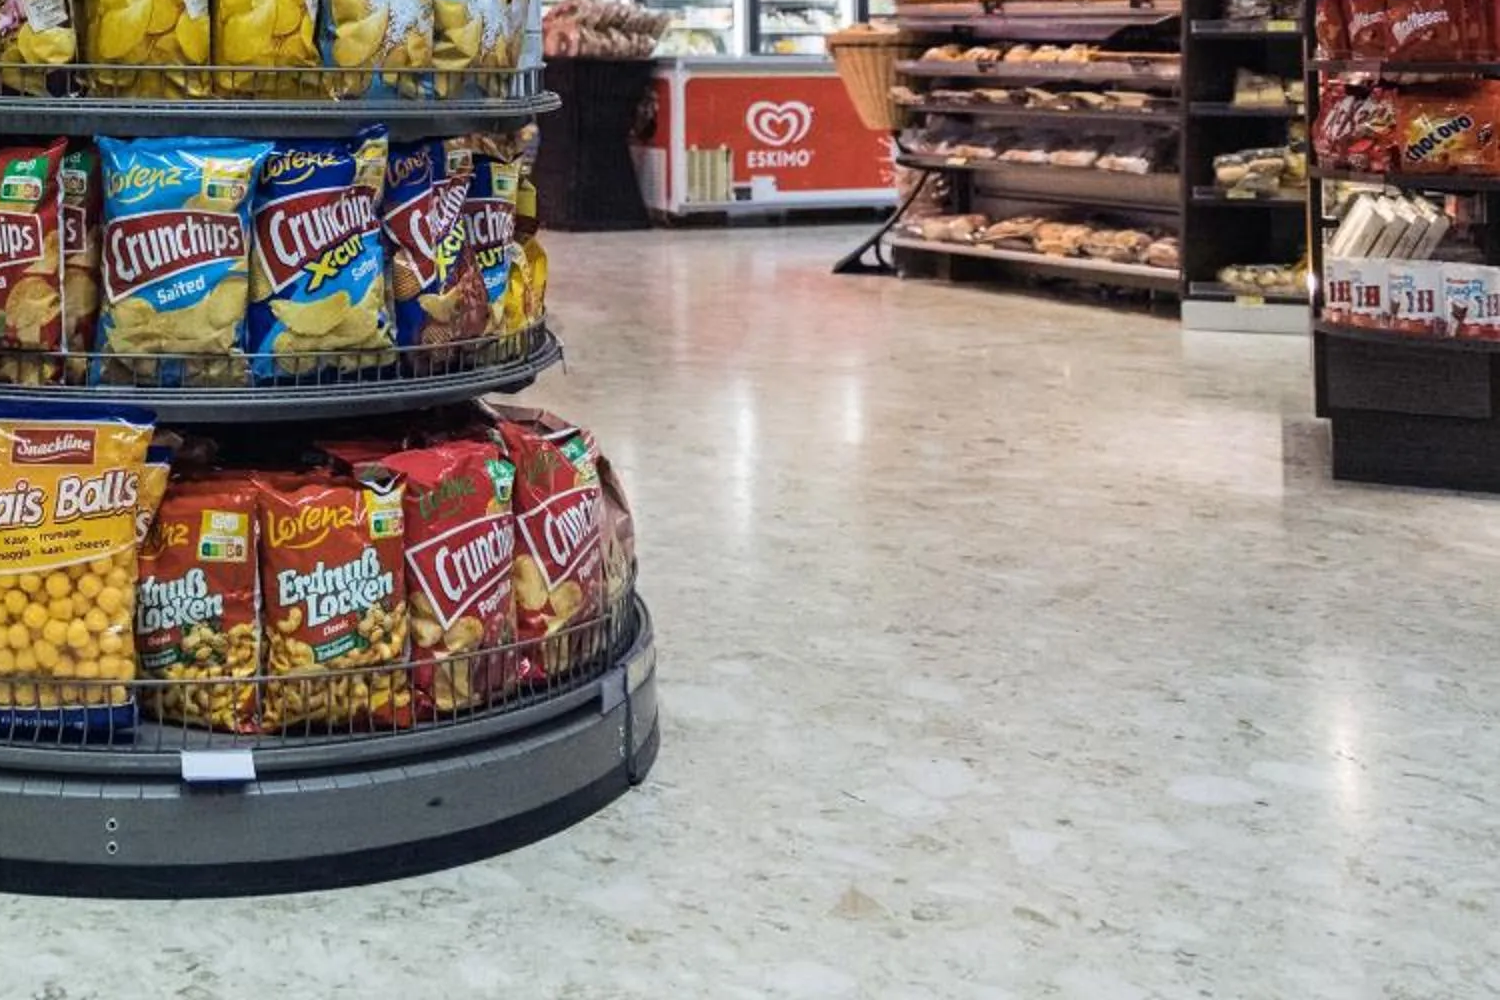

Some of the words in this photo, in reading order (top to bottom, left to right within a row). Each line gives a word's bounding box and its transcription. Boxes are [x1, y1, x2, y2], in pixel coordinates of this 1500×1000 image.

[260, 149, 338, 184] Lorenz
[746, 149, 811, 169] ESKIMO
[110, 214, 241, 283] Crunchips
[269, 191, 376, 268] Crunchip
[156, 275, 206, 305] Salted
[15, 437, 93, 458] Snackline
[53, 470, 140, 521] Balls
[39, 527, 82, 542] fromage
[74, 538, 111, 551] cheese
[266, 503, 356, 549] Lorenz
[276, 546, 381, 607] Erdnuß
[307, 570, 394, 628] Locken
